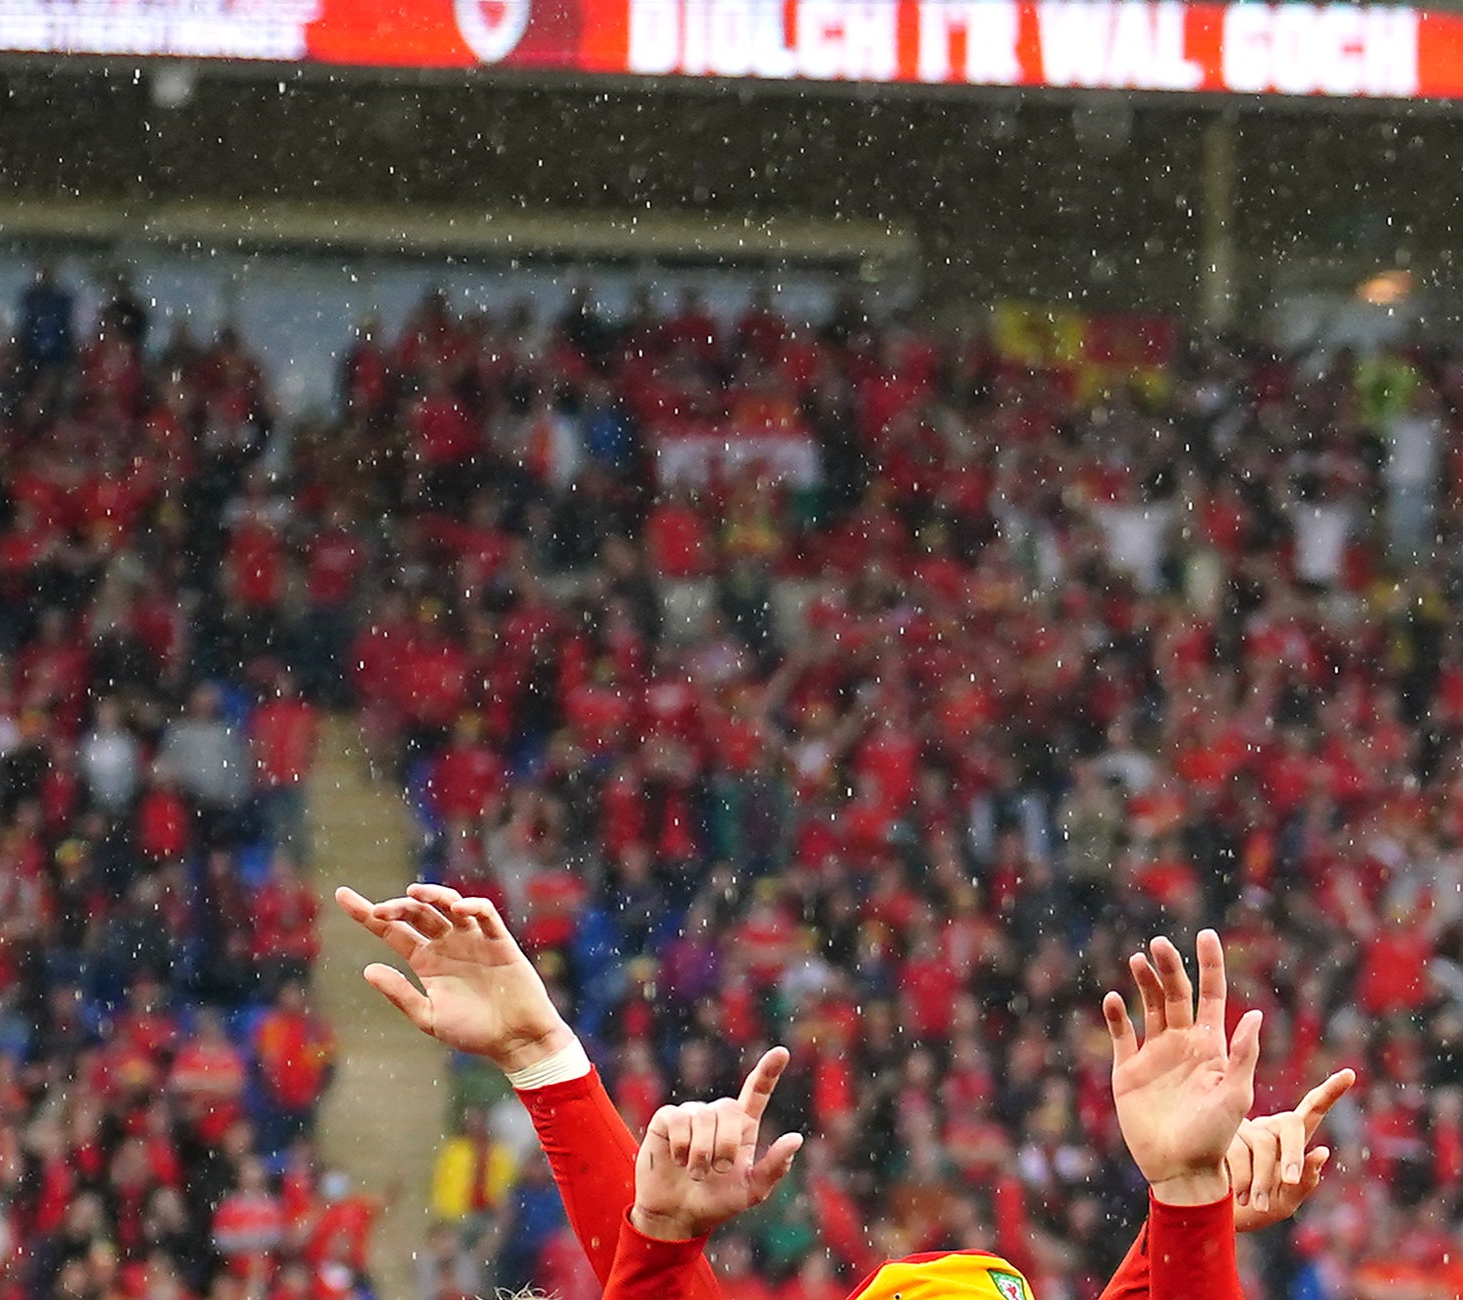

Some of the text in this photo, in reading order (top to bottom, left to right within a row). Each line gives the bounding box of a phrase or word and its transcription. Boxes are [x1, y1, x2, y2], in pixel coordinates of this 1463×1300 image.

[629, 0, 896, 77] DIOLCH
[1038, 0, 1204, 89] WAL
[1222, 4, 1418, 95] GOCH
